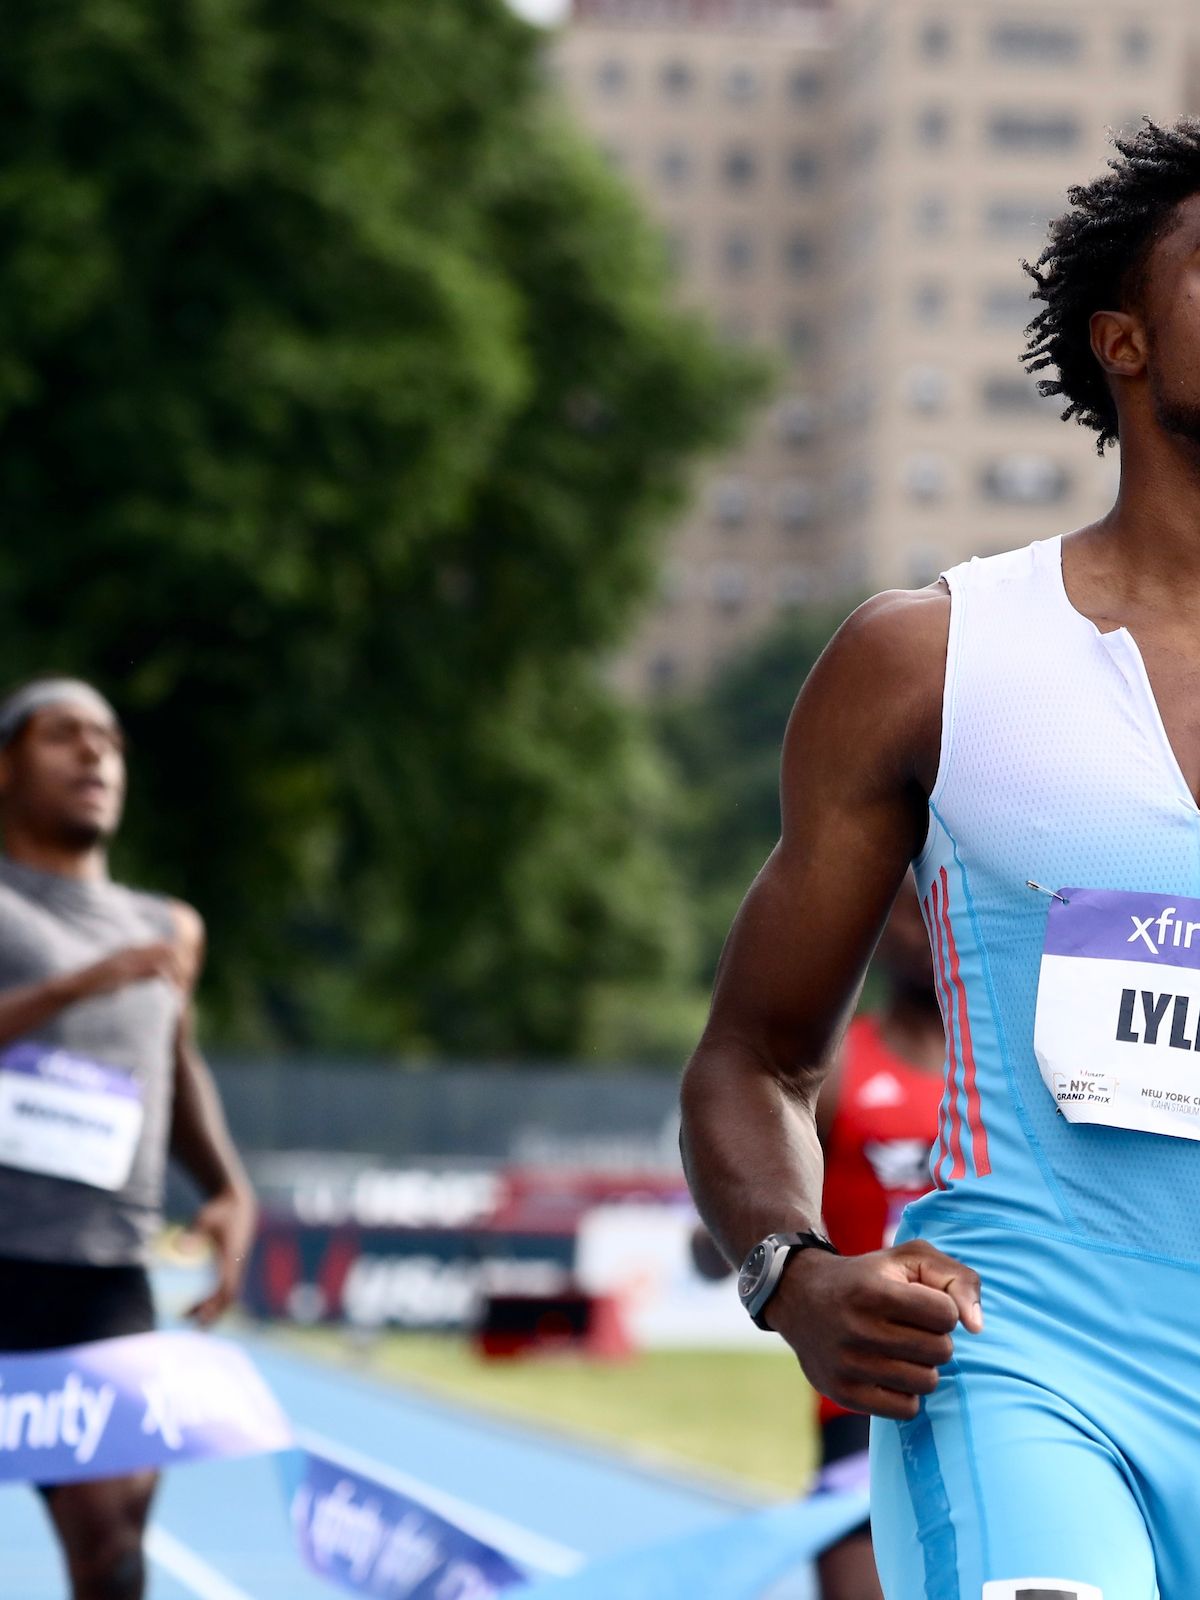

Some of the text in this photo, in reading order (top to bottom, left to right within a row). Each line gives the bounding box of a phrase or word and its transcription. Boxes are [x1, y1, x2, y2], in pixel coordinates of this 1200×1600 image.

[1070, 1079, 1096, 1093] NYC
[1056, 1093, 1111, 1104] GRAND PRIX
[1141, 1088, 1163, 1099] NEW
[1165, 1092, 1191, 1104] YORK
